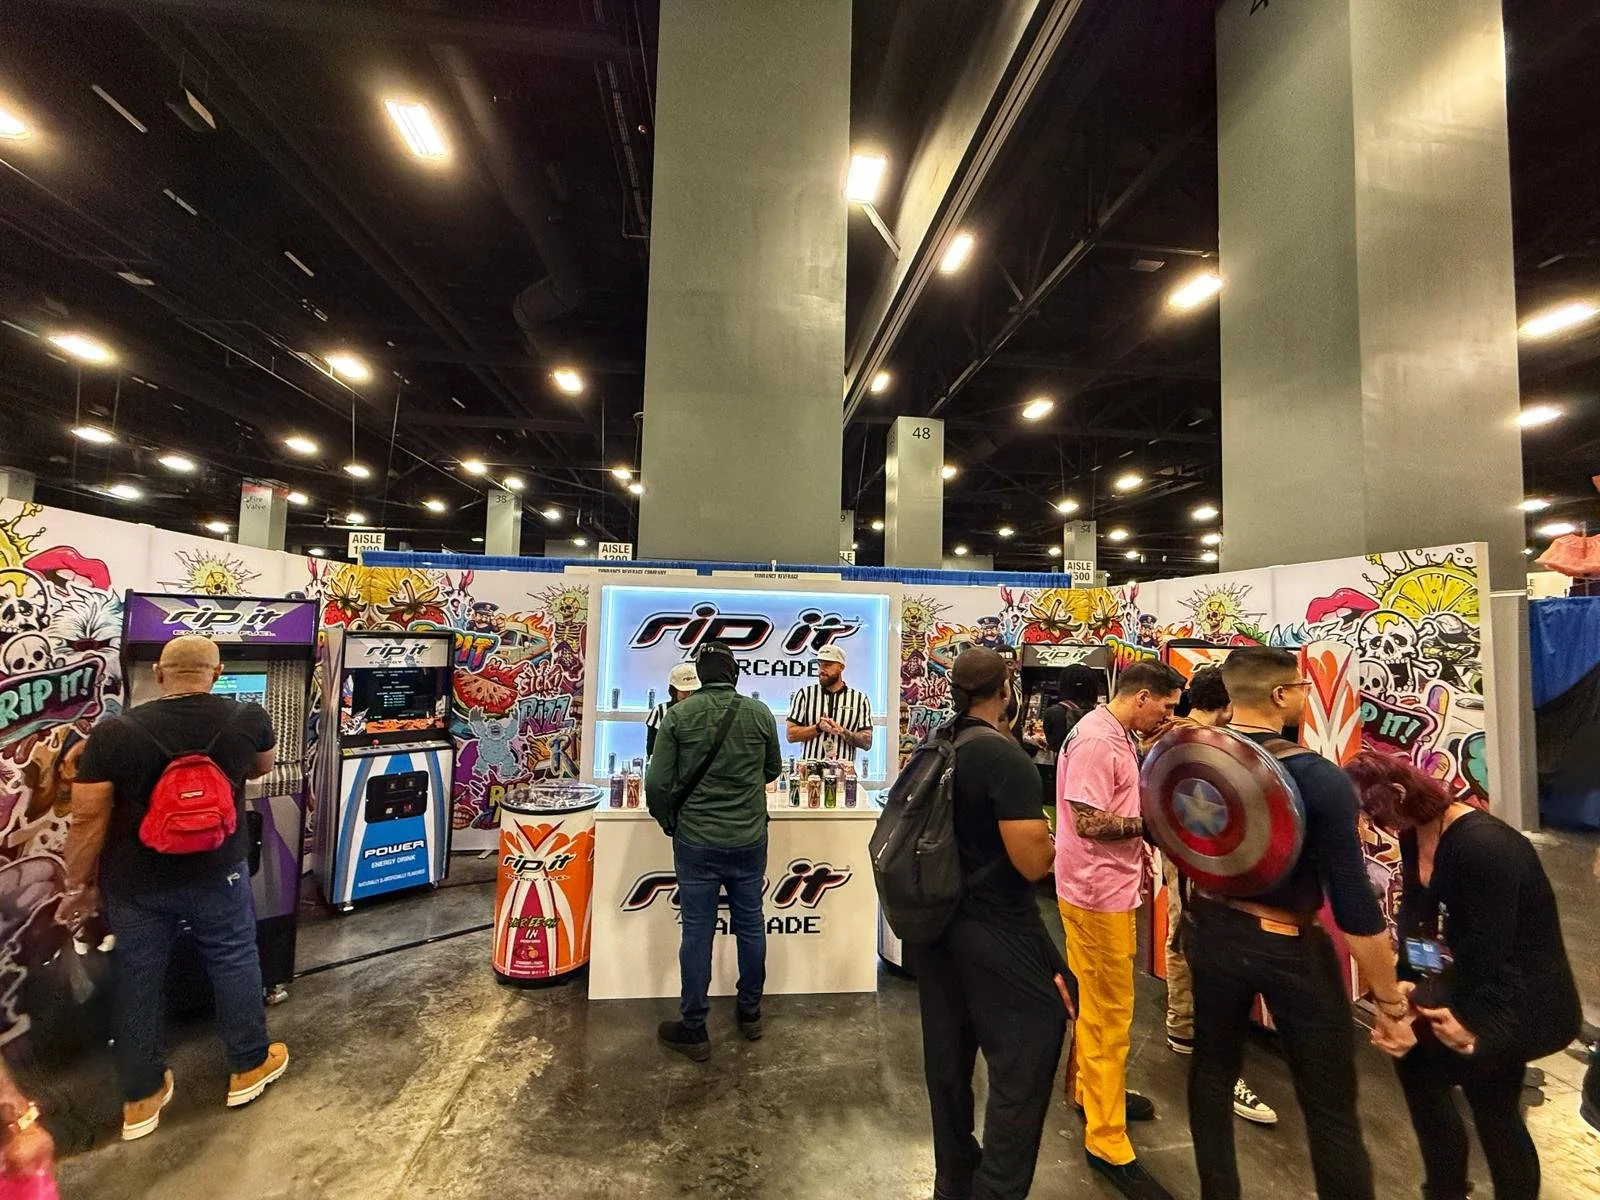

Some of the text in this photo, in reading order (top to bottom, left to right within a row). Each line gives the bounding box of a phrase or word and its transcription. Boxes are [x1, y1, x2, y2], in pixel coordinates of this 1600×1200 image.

[912, 427, 931, 440] 48
[352, 534, 383, 544] AISLE
[602, 543, 630, 554] AISLE
[1067, 562, 1092, 570] AISLE
[163, 605, 285, 630] rip it
[629, 602, 862, 661] rip it
[365, 643, 431, 660] rip it
[737, 658, 820, 678] RCADE
[520, 671, 563, 693] SICK!
[0, 667, 93, 728] RIP IT!
[1379, 711, 1421, 744] IT!
[364, 840, 425, 859] POWER
[370, 854, 416, 869] ENERGY DRINK
[502, 852, 577, 876] rip it
[771, 858, 853, 910] it
[715, 916, 821, 935] AADE
